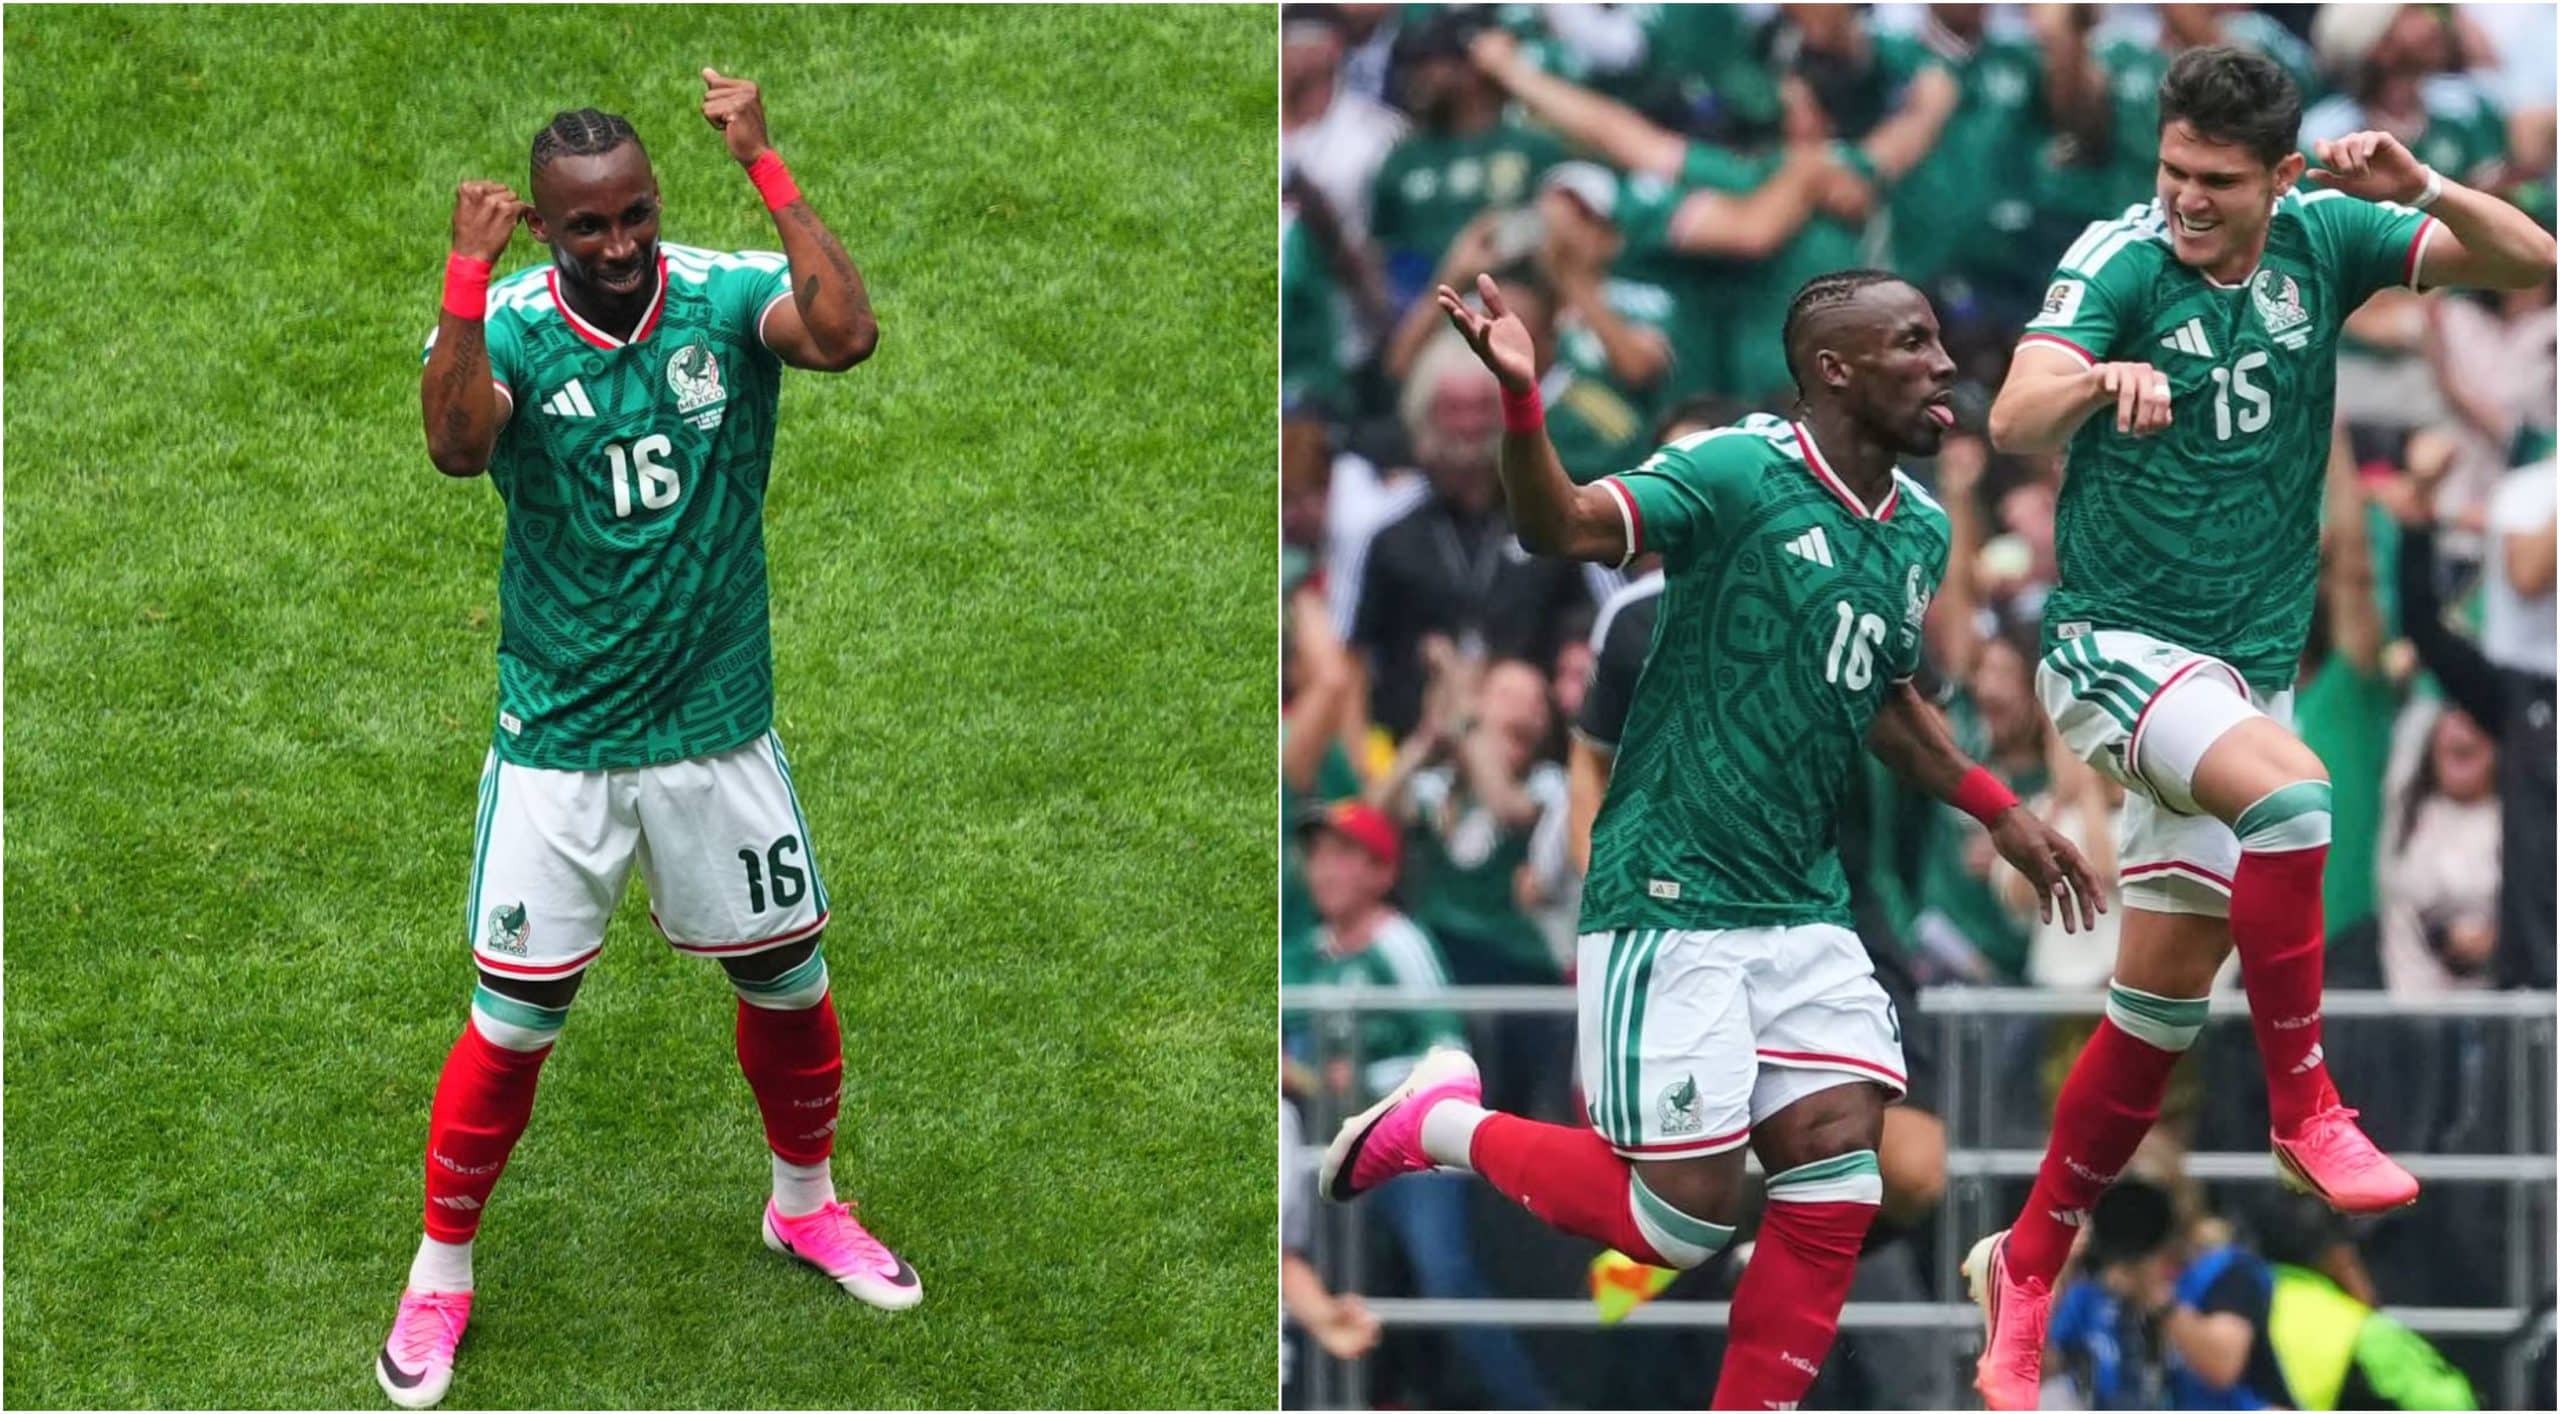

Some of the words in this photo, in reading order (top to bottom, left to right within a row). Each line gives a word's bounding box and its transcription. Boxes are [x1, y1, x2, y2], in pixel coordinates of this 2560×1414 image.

[2211, 351, 2271, 440] 15
[604, 434, 680, 518] 16
[1826, 600, 1886, 691] 16
[738, 834, 806, 914] 16
